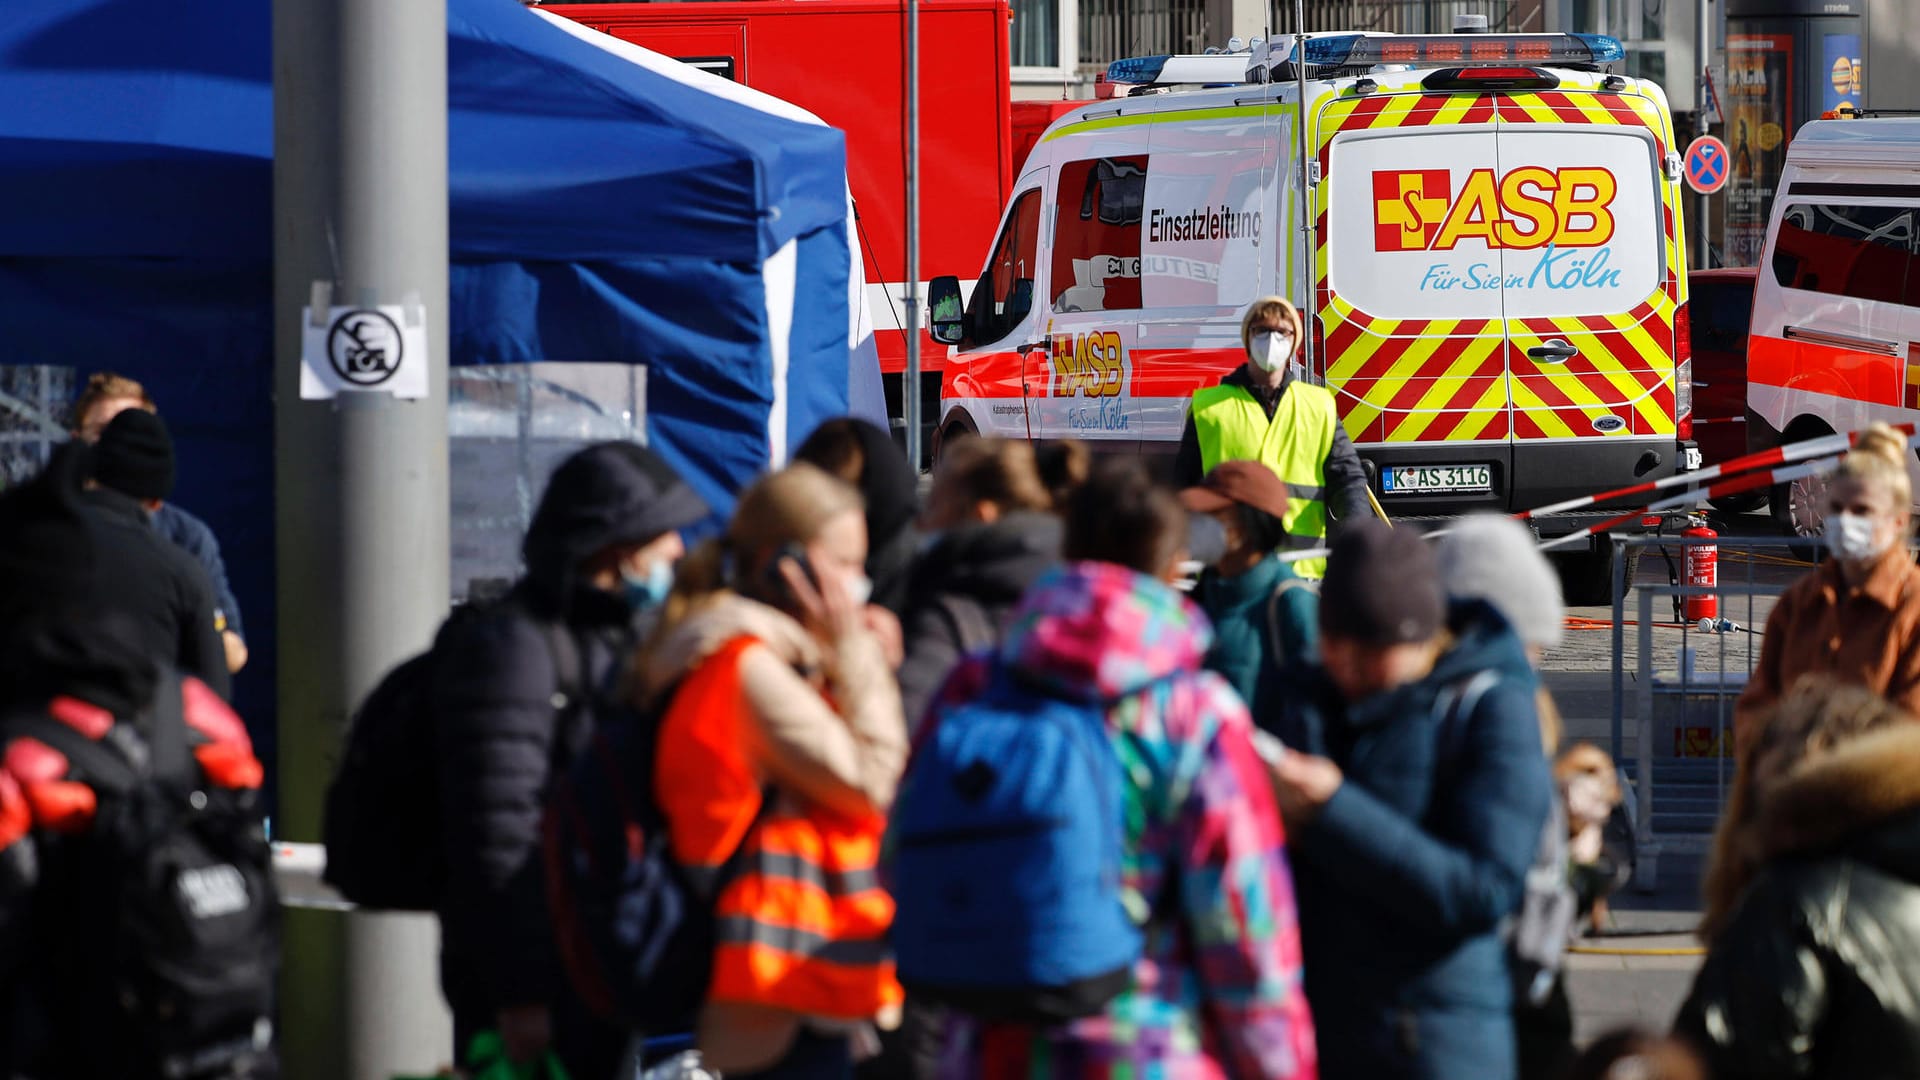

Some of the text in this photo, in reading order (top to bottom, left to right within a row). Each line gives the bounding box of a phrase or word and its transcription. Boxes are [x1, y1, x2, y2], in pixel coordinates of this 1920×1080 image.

[1149, 204, 1262, 248] Einsatzleitung
[1430, 165, 1617, 250] ASB
[1419, 242, 1621, 291] Für Sie in Köln
[1067, 330, 1124, 398] ASB
[1099, 393, 1129, 431] Köln
[1393, 466, 1489, 488] K AS 3116
